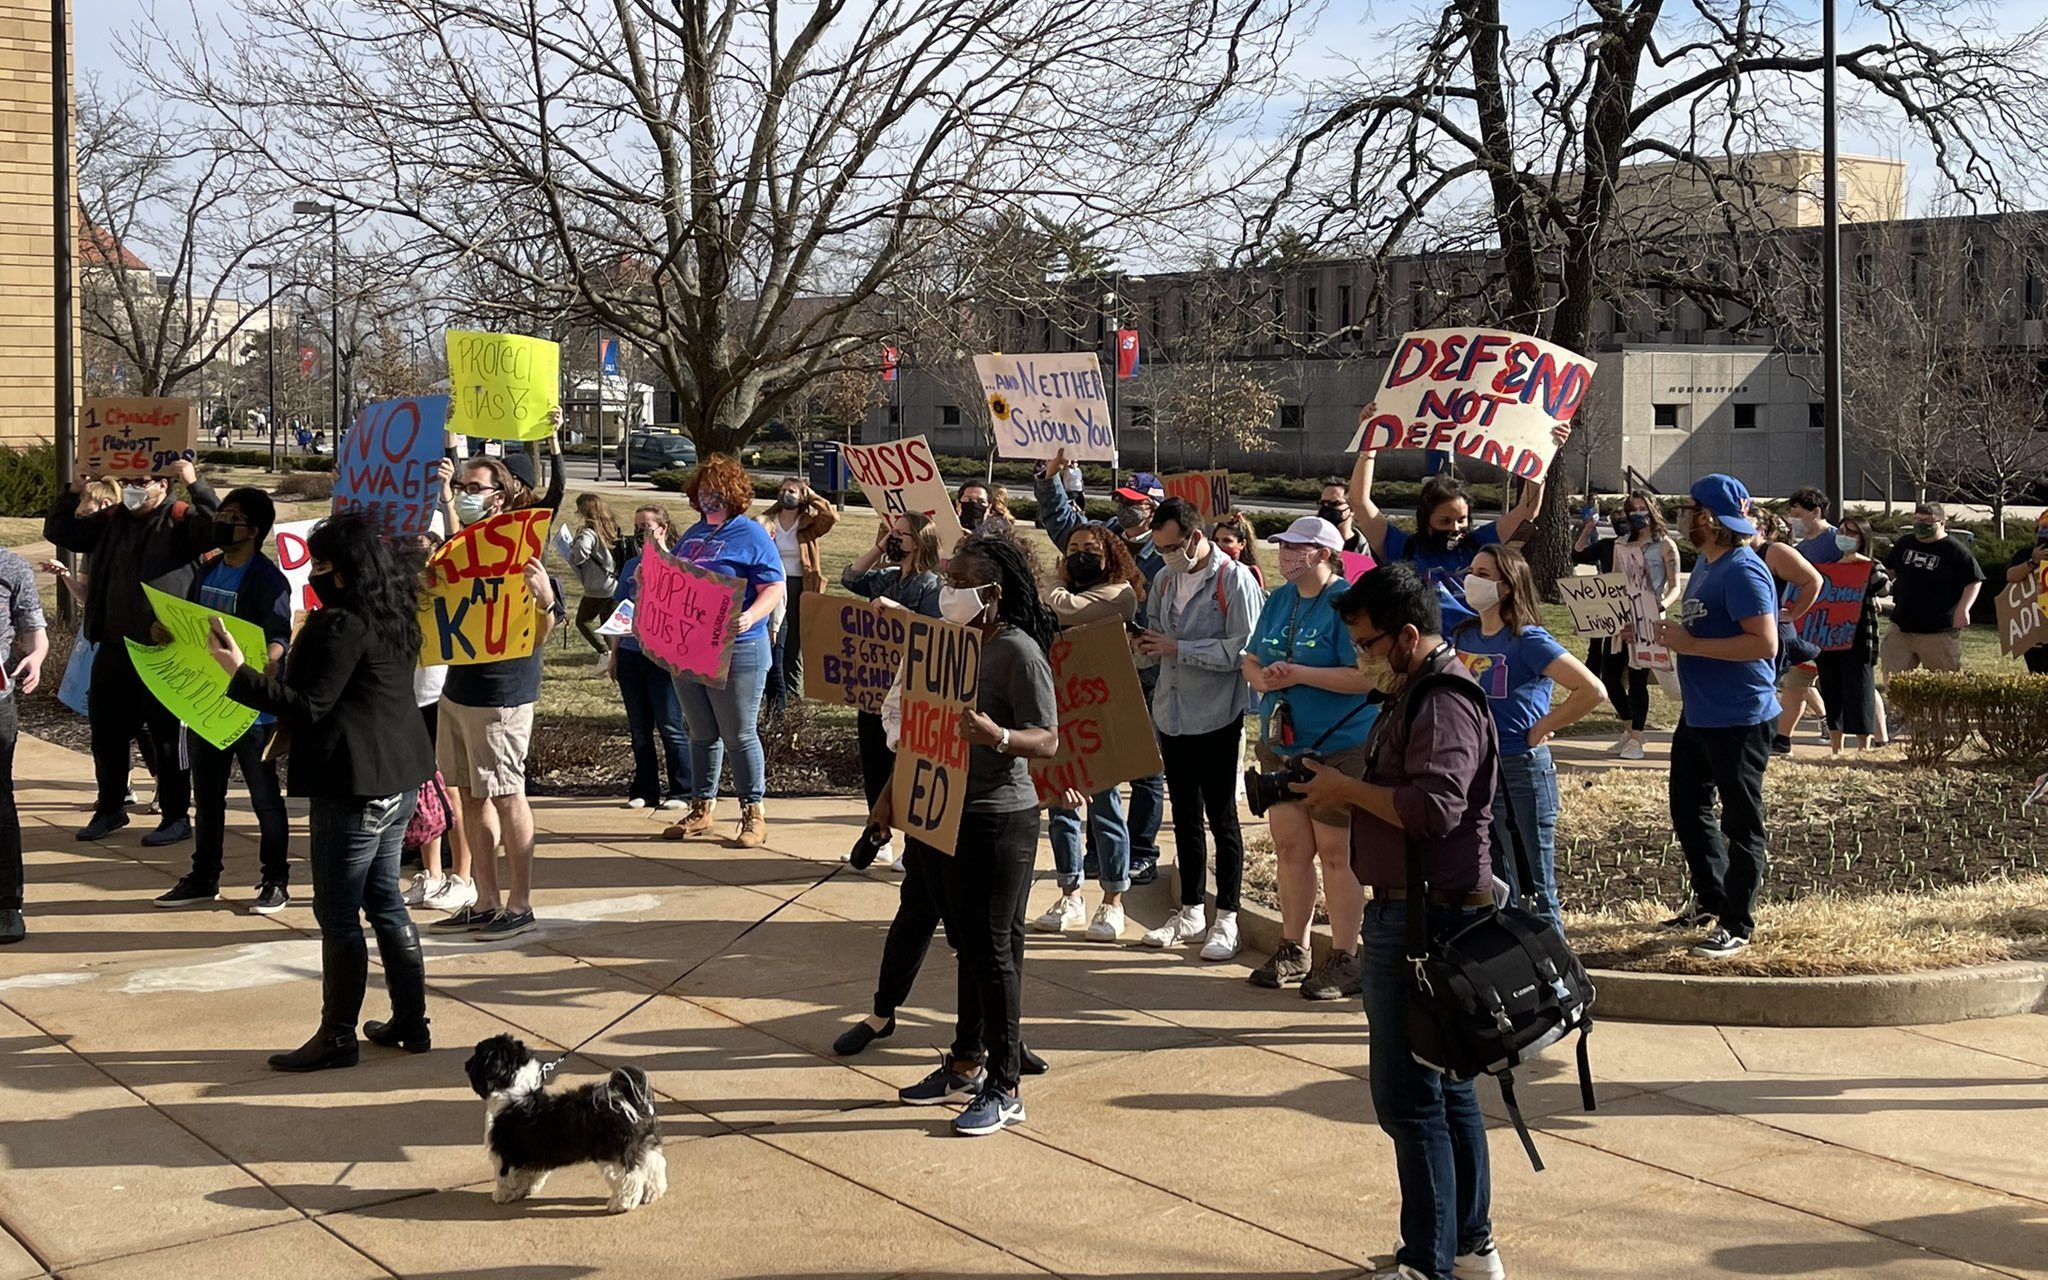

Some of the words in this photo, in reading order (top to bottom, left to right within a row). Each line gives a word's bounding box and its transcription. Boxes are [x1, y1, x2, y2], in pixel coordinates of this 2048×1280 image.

[1016, 361, 1105, 400] NEITHER
[1385, 334, 1591, 420] DEFEND
[1668, 386, 1748, 394] HUMANITIES
[85, 407, 101, 428] 1
[104, 406, 181, 426] Chancellor
[1416, 387, 1518, 426] NOT
[343, 401, 421, 464] NO
[1010, 407, 1081, 447] SHOULD
[1074, 407, 1112, 448] YOU
[1359, 414, 1543, 479] DEFUND
[109, 450, 149, 470] 56
[349, 459, 442, 502] WAGE
[843, 440, 934, 486] CRISIS
[884, 488, 907, 513] AT
[1211, 475, 1230, 517] KU
[427, 510, 551, 590] RISIS
[470, 577, 504, 605] AT
[650, 558, 685, 608] STOP
[682, 587, 708, 625] the
[1561, 580, 1596, 602] We
[2009, 568, 2041, 609] CU
[434, 593, 510, 660] KU
[841, 605, 905, 644] GIROD
[1568, 605, 1615, 635] Living
[906, 622, 980, 703] FUND
[1059, 719, 1102, 754] TS
[907, 758, 949, 831] ED
[1512, 984, 1536, 998] Canon
